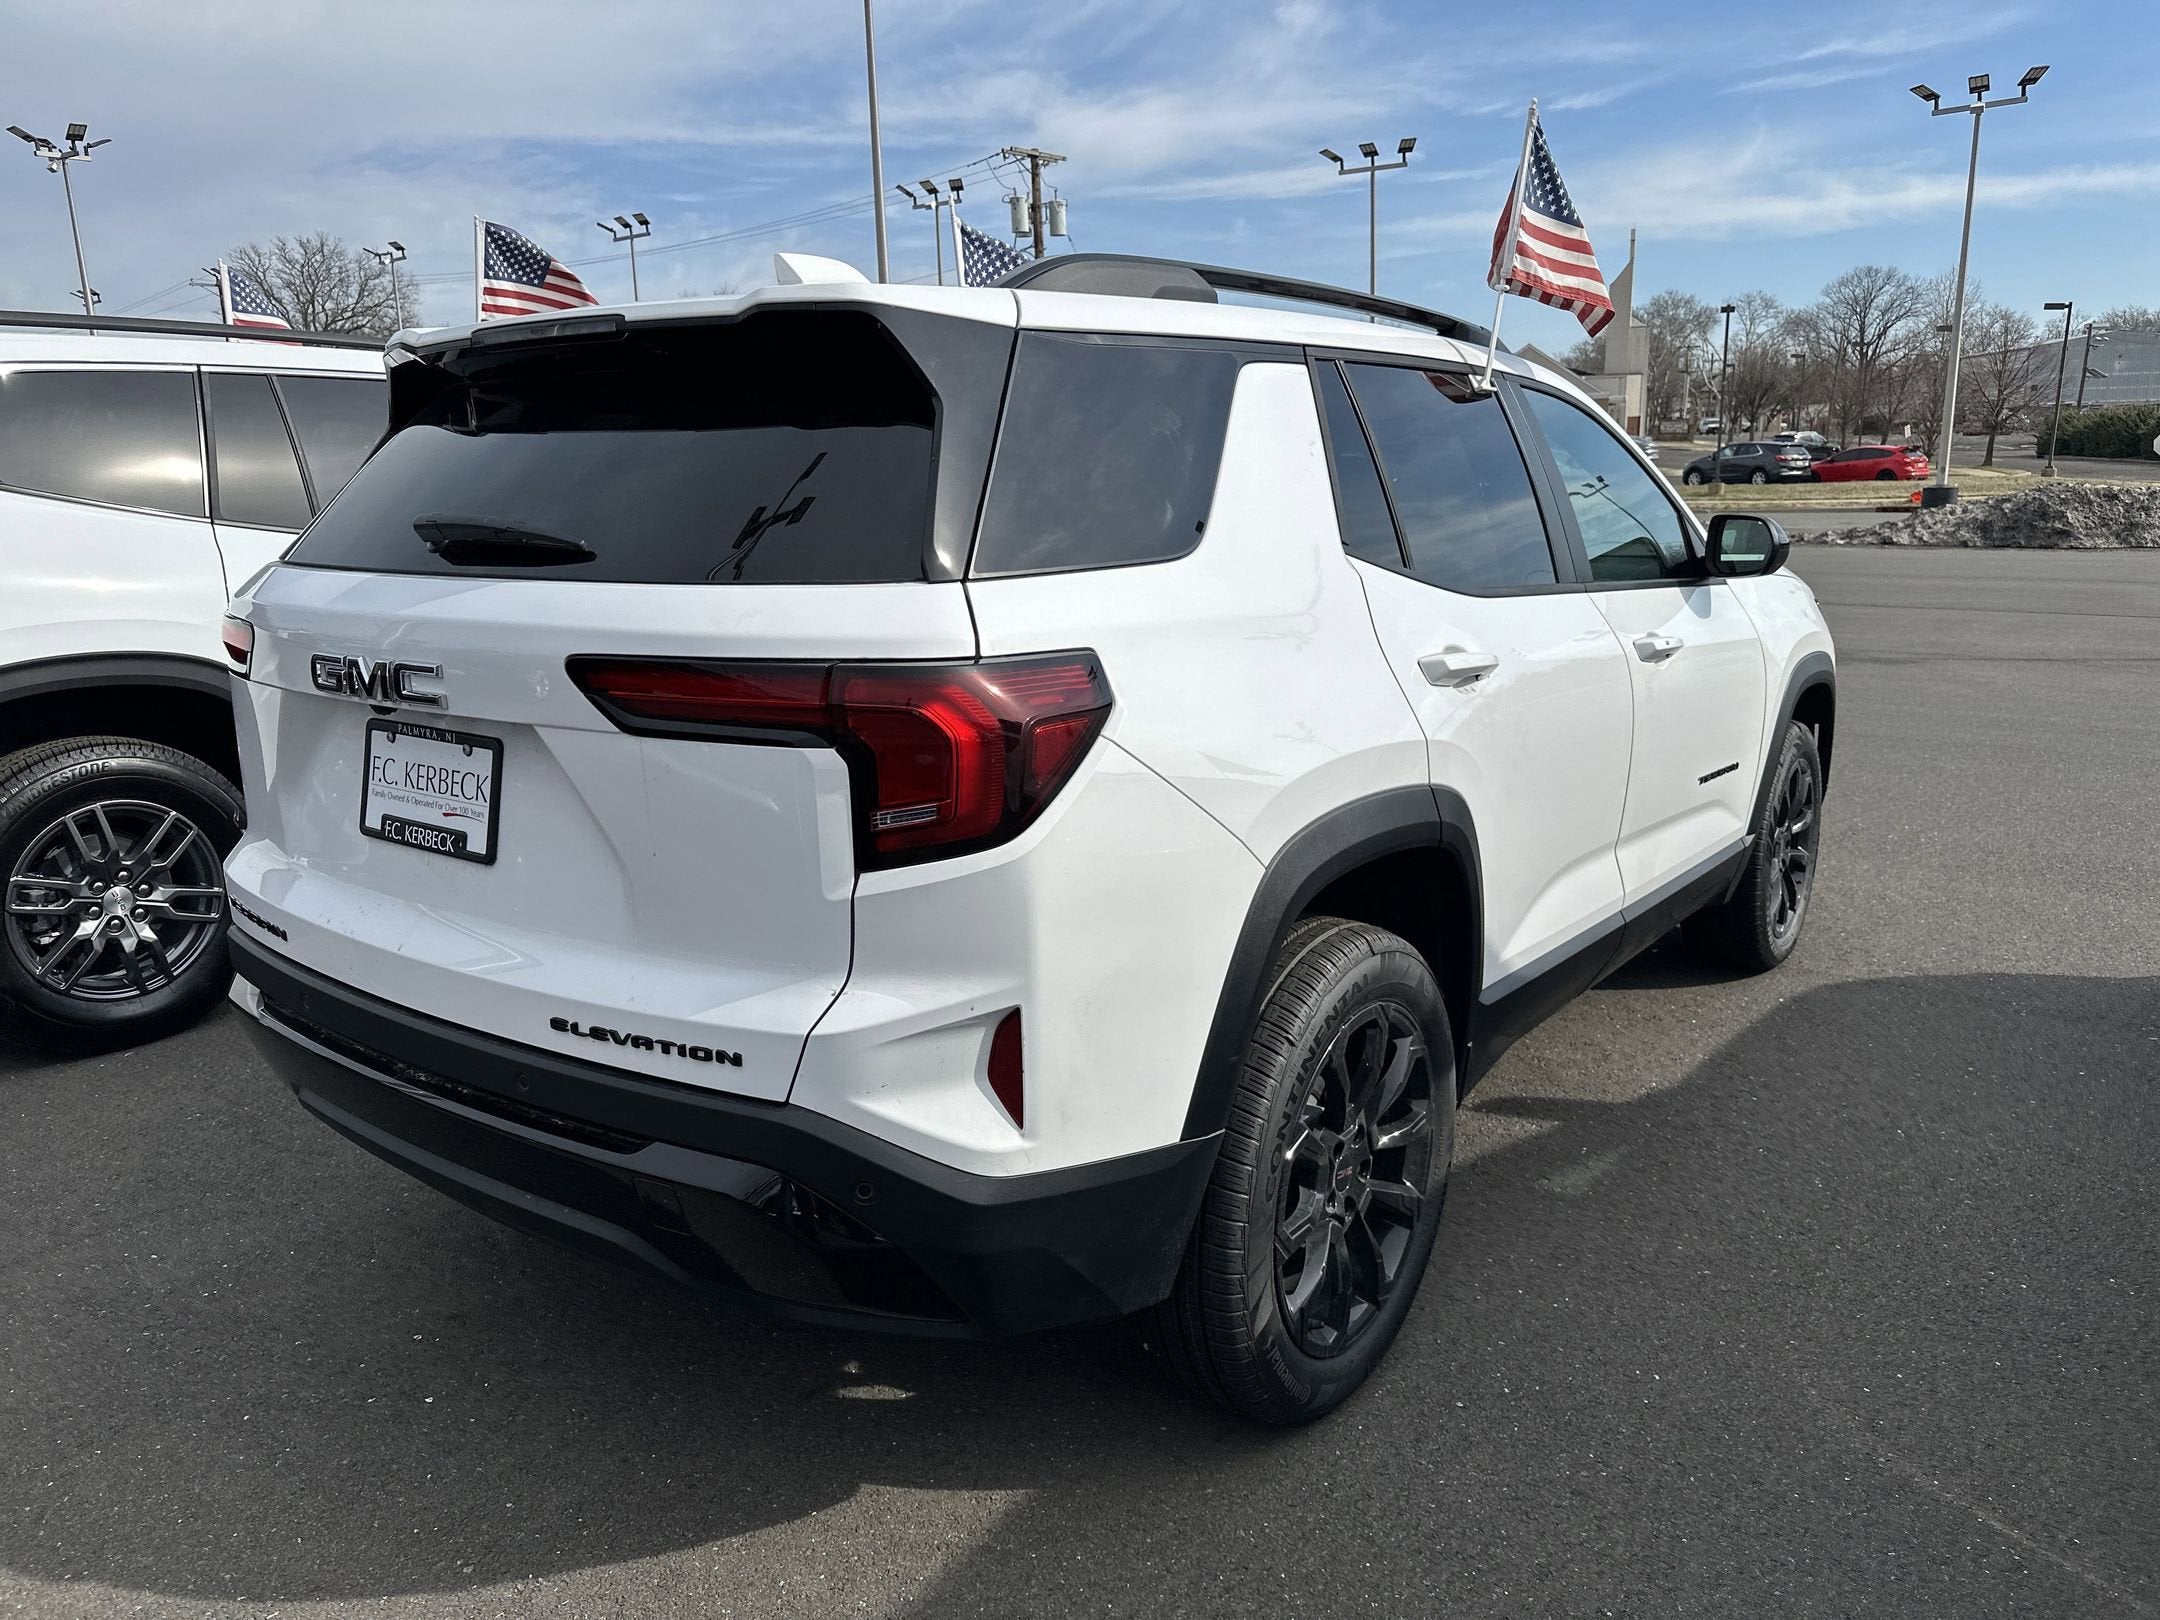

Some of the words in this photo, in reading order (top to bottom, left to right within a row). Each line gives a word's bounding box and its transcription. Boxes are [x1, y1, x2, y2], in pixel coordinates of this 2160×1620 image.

[310, 653, 449, 709] GMC
[398, 724, 441, 740] PALMYRA,
[445, 733, 456, 744] NJ
[371, 755, 398, 786] F.C.
[404, 761, 489, 803] KERBECK
[371, 788, 387, 799] Family
[388, 791, 405, 803] Owned
[411, 797, 435, 809] Operated
[435, 801, 443, 811] For
[445, 803, 458, 812] Over
[459, 806, 469, 815] 100
[470, 809, 484, 819] Years
[385, 820, 402, 840] F.C.
[404, 824, 455, 853] KERBECK
[549, 1016, 743, 1067] ELEVATION
